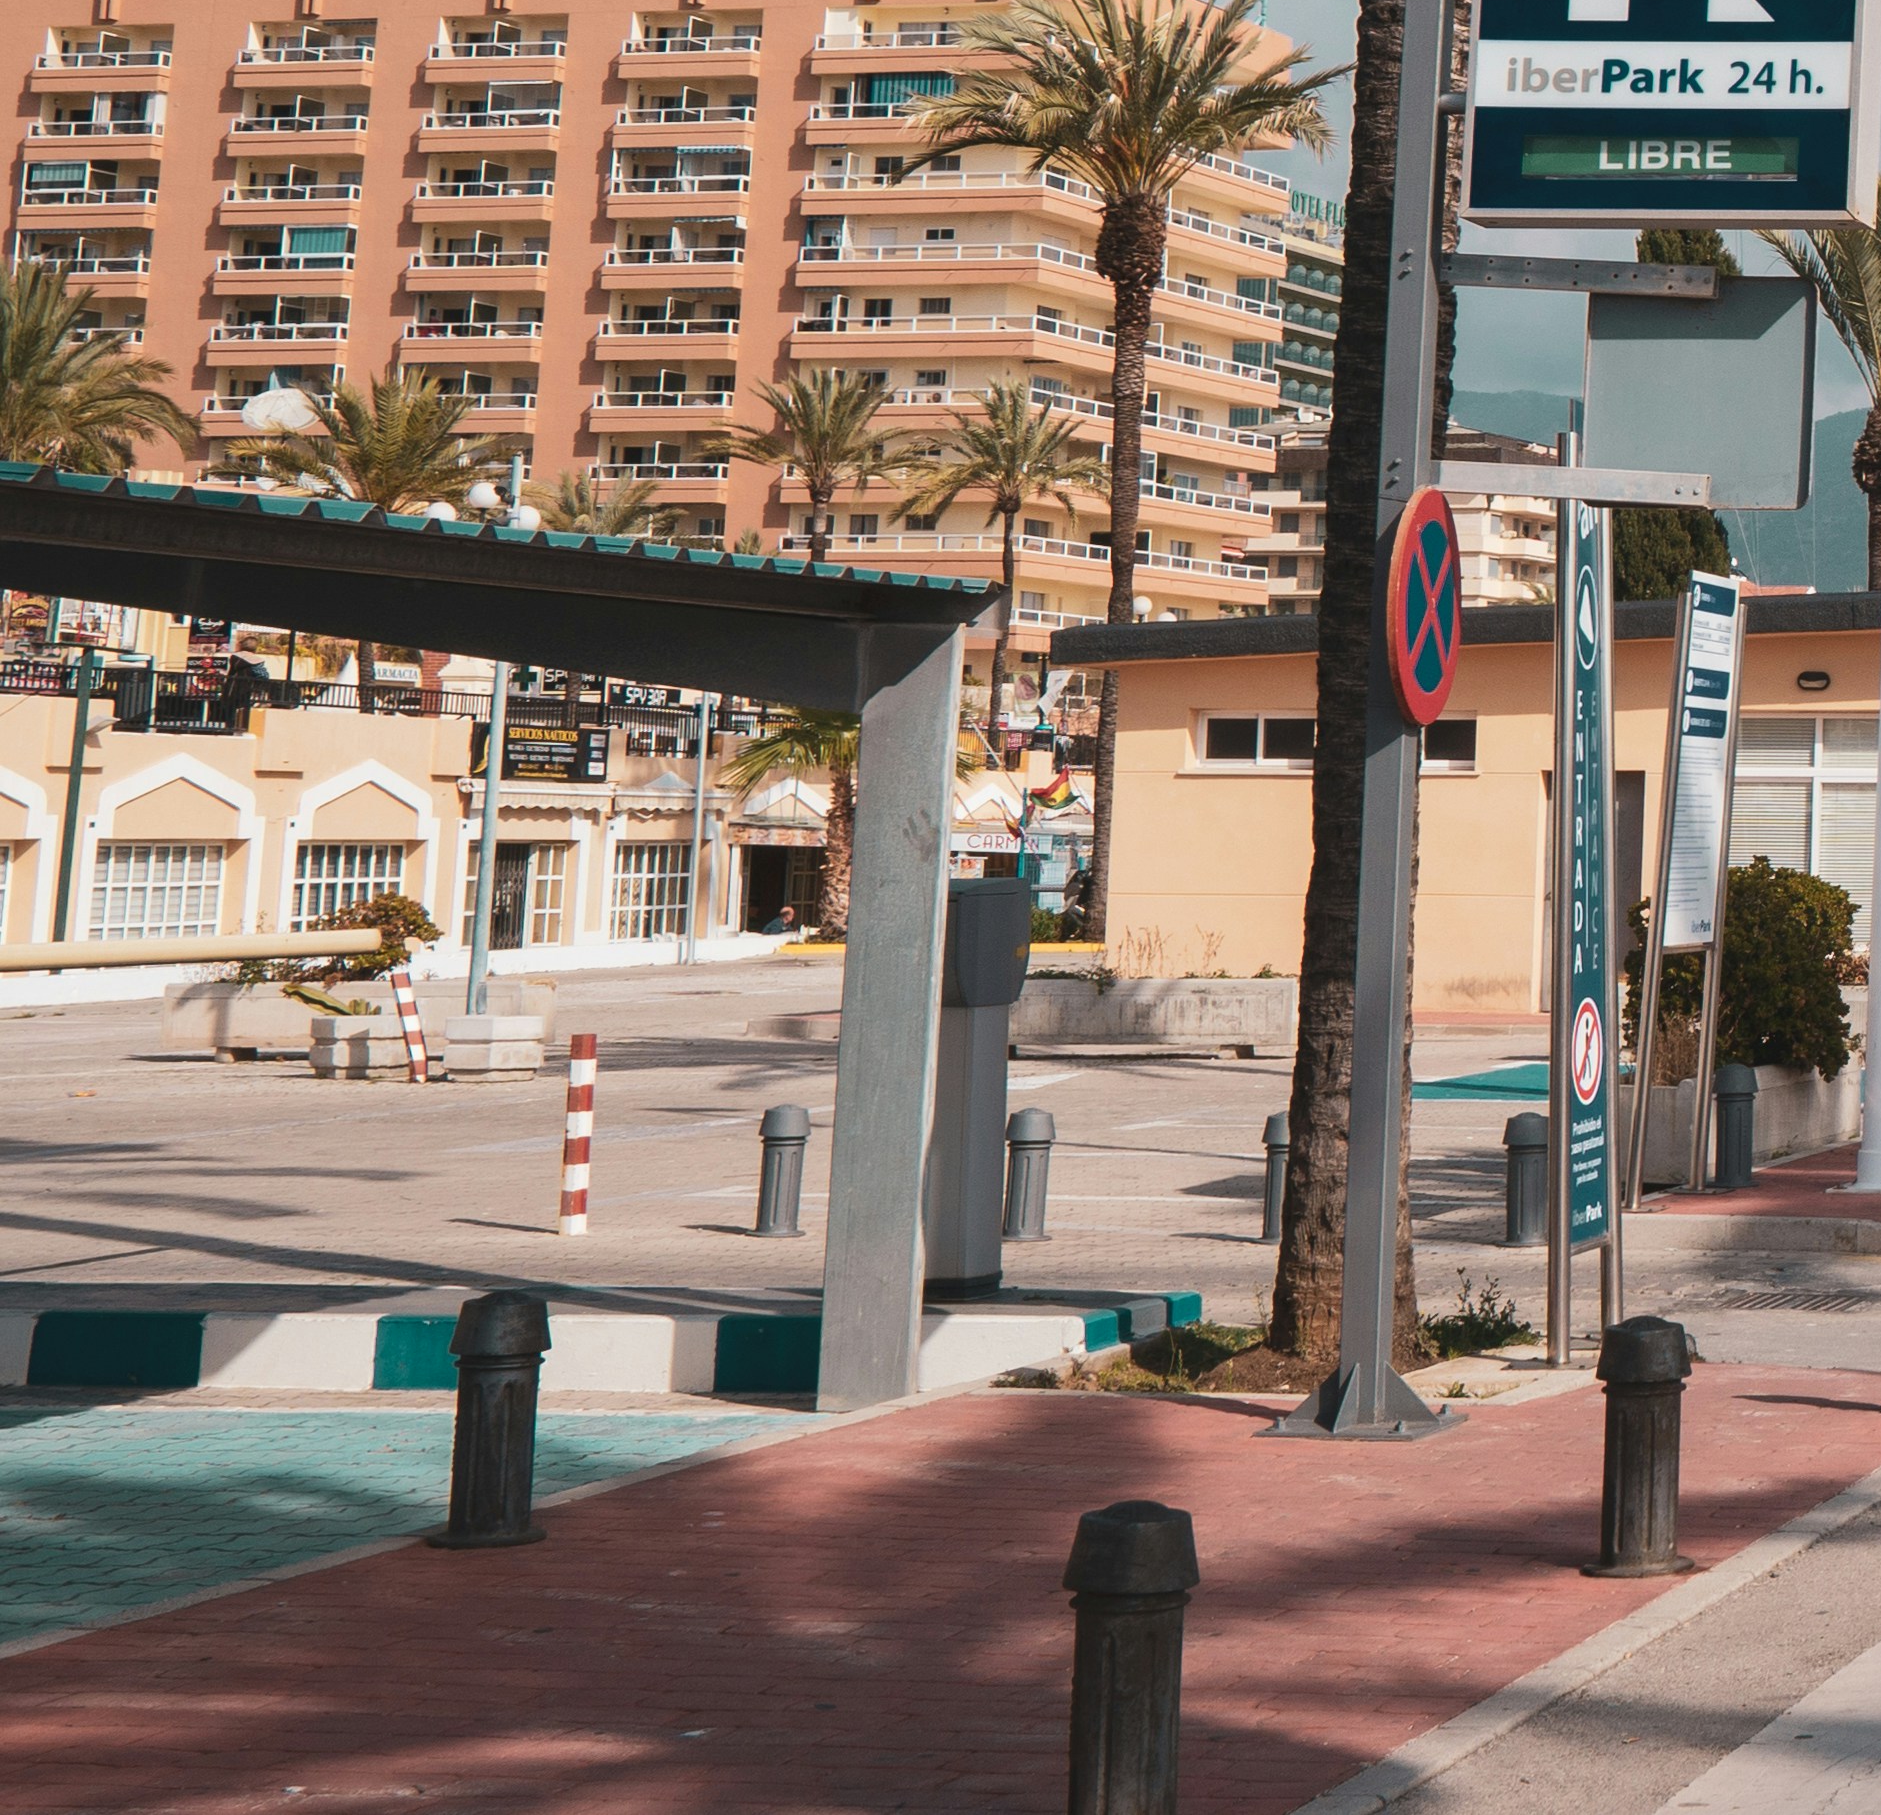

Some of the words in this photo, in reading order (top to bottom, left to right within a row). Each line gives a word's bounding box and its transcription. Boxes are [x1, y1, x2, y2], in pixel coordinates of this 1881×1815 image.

[1506, 57, 1705, 95] iberPark
[1727, 61, 1777, 95] 24
[1789, 58, 1824, 95] h.
[1599, 139, 1733, 172] LIBRE
[1291, 189, 1325, 221] OTEL
[376, 667, 419, 680] ARMACIA
[967, 834, 1039, 849] CARMN
[1573, 690, 1584, 975] ENTRADA
[1590, 690, 1598, 970] ENTRANCE
[1572, 1201, 1603, 1227] iberPark
